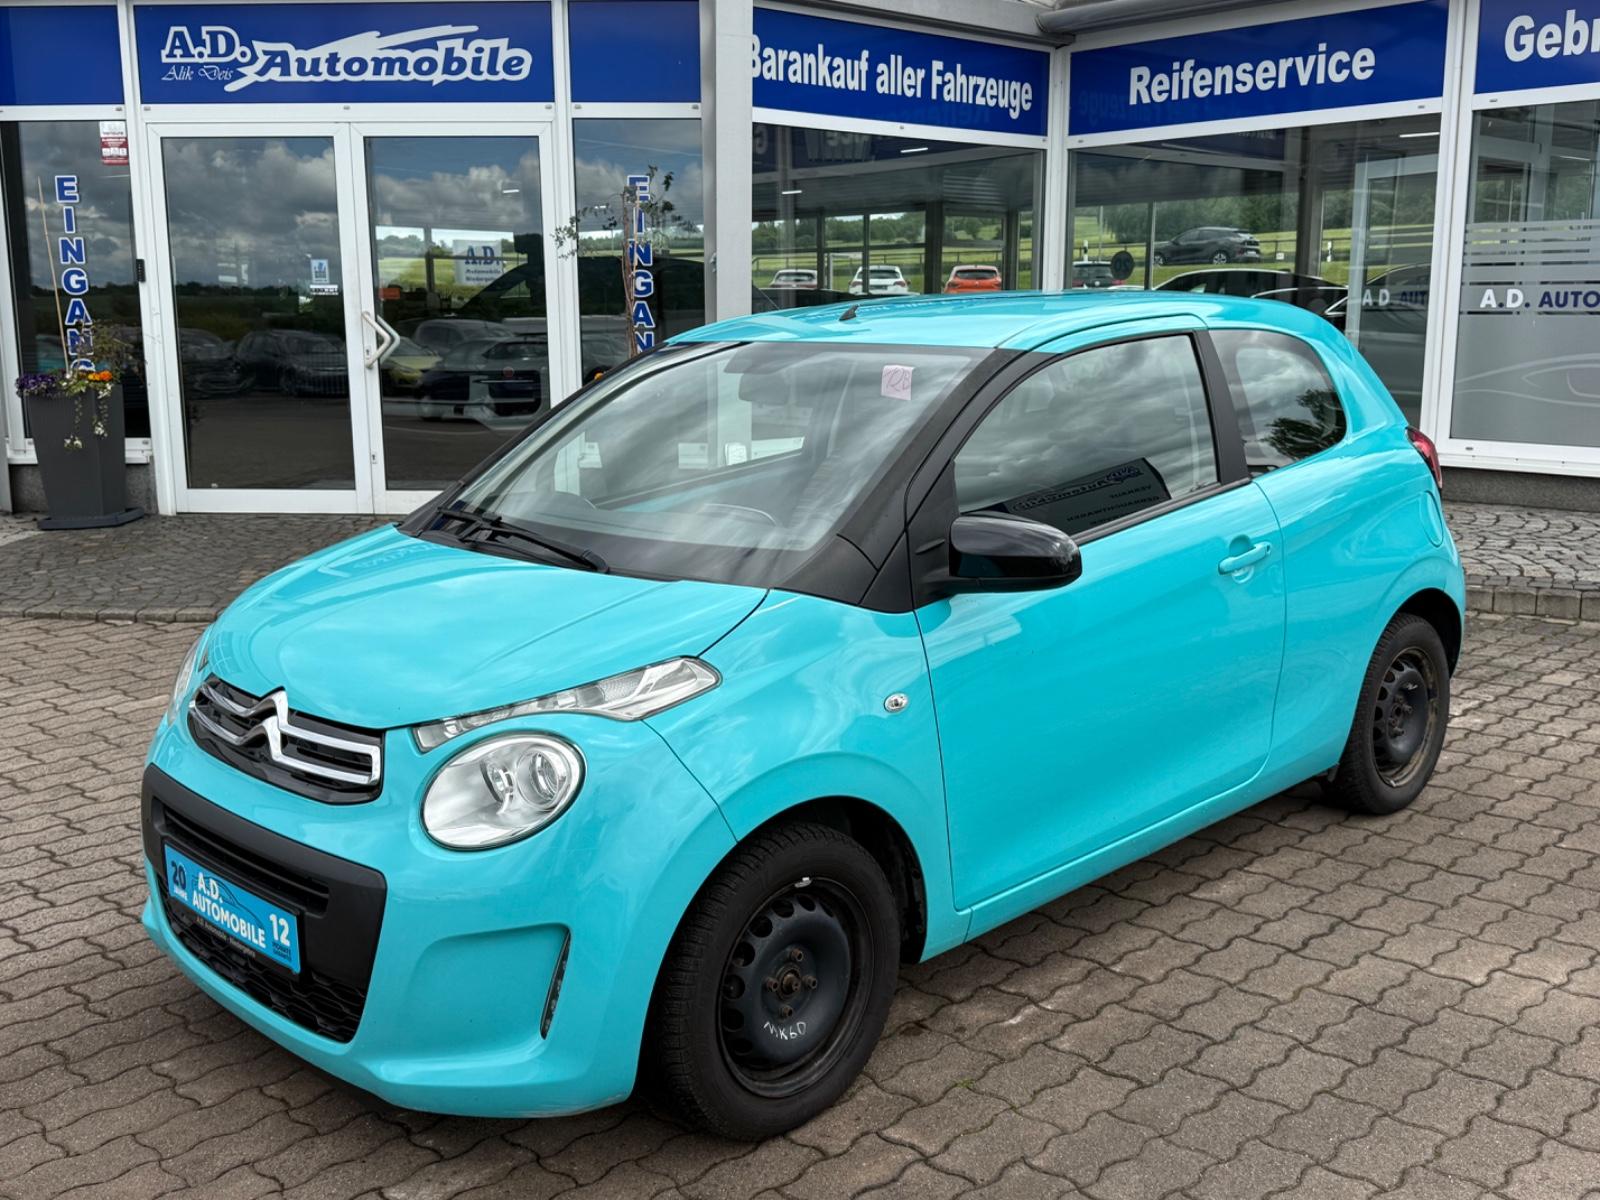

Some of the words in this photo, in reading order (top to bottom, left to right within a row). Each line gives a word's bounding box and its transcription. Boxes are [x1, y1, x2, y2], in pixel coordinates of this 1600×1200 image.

[161, 26, 251, 63] A.D.
[249, 37, 533, 87] Automobile
[161, 64, 194, 81] Alik
[197, 64, 233, 81] Deis
[875, 54, 926, 98] aller
[931, 59, 1033, 120] Fahrzeuge
[1129, 43, 1376, 106] Reifenservice
[1480, 289, 1530, 308] A.D.
[171, 860, 187, 890] 20
[197, 872, 224, 904] A.D.
[192, 890, 267, 948] AUTOMOBILE
[268, 914, 291, 947] 12
